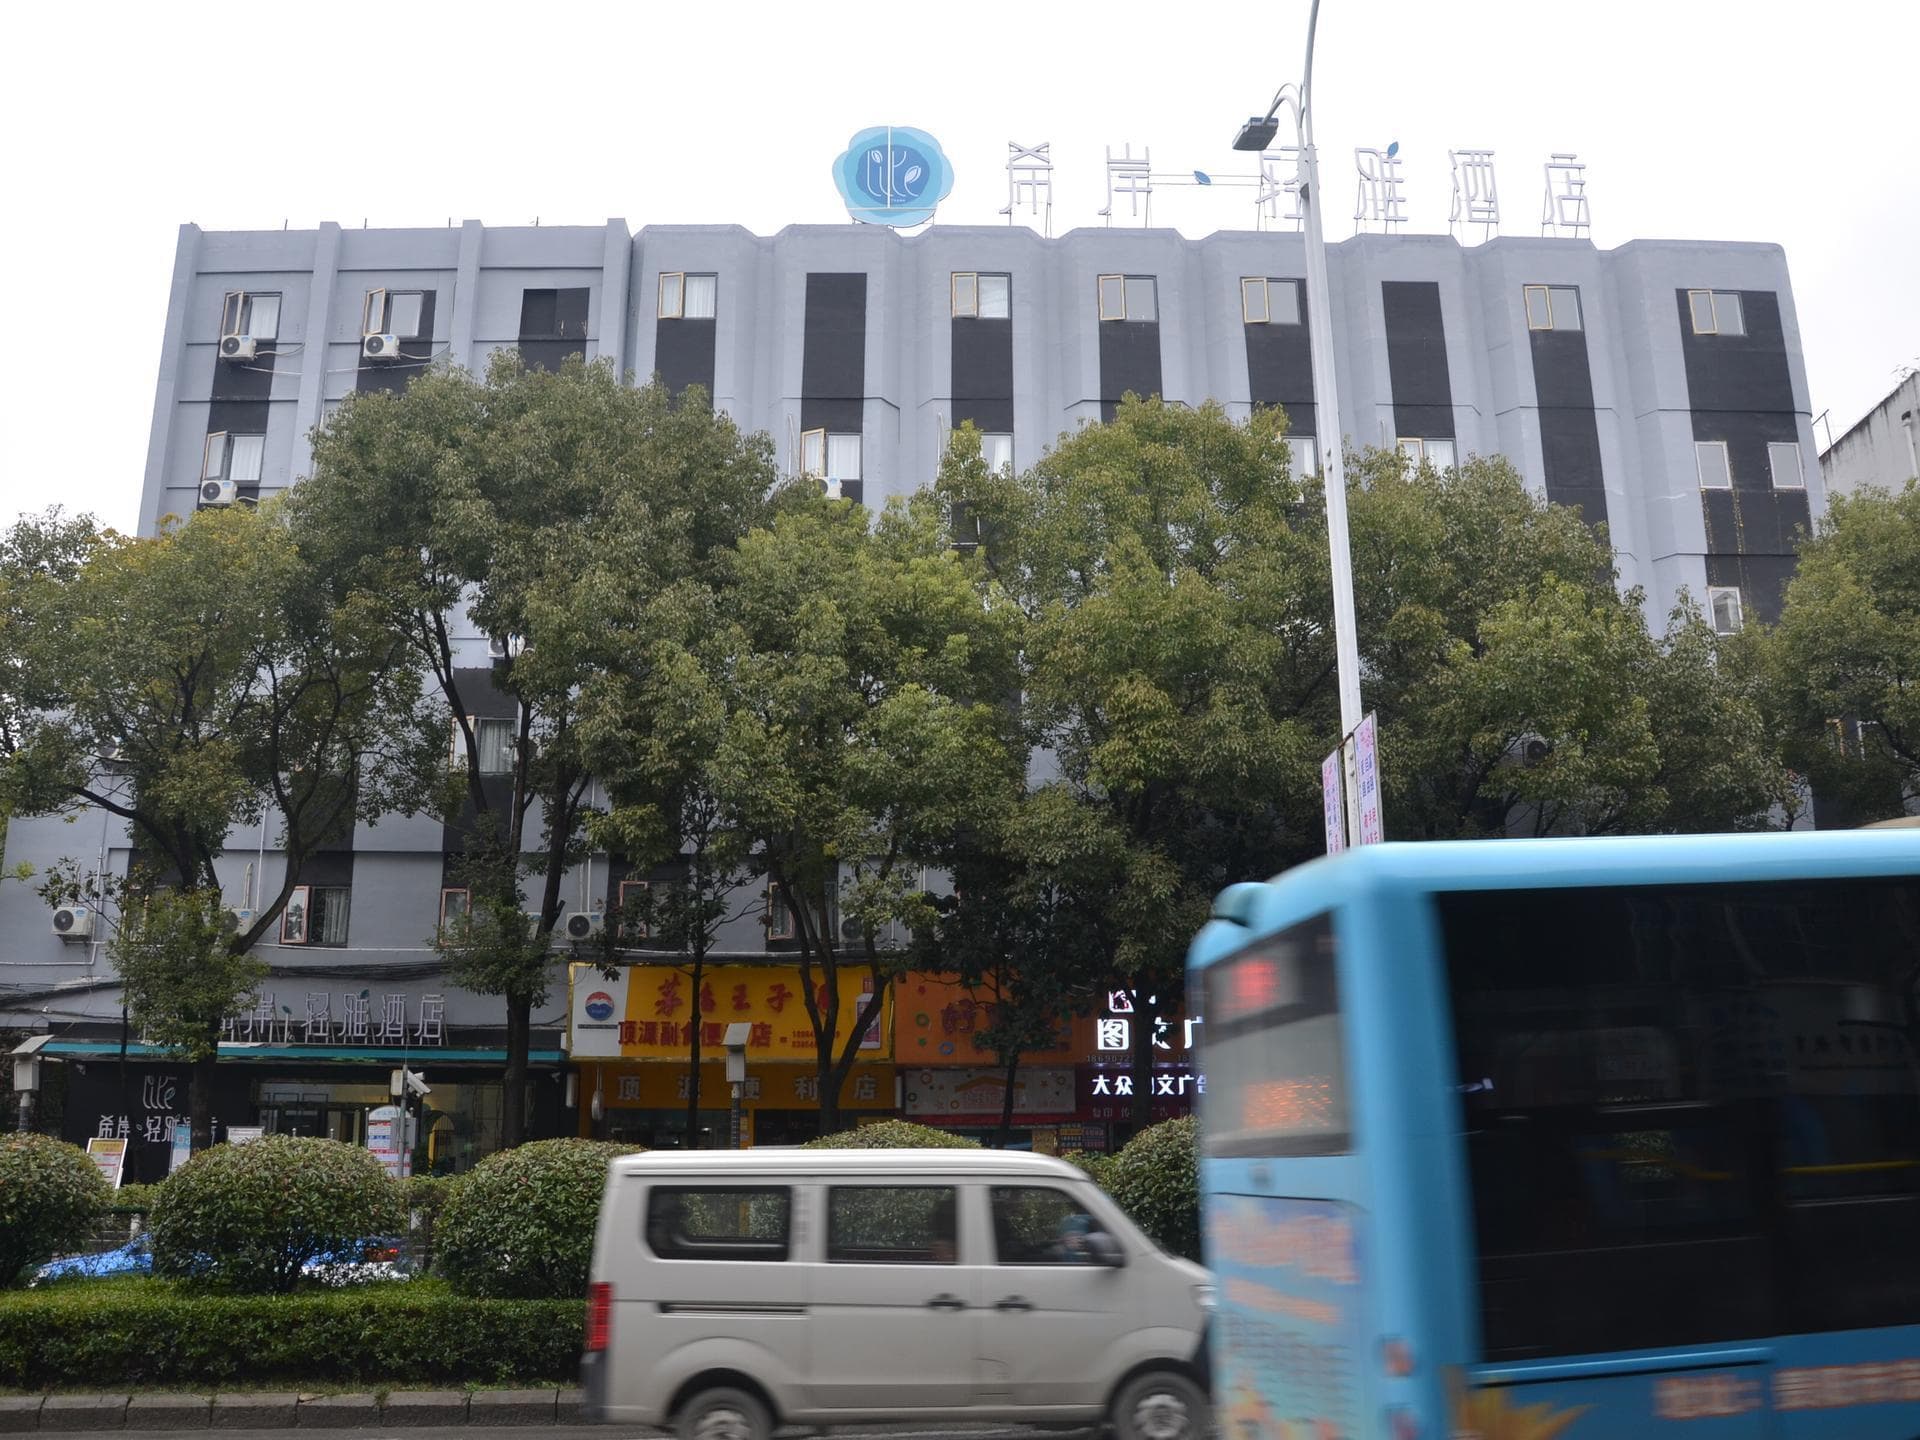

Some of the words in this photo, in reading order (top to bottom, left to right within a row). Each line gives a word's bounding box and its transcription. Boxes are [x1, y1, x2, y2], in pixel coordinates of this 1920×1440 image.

[1091, 1073, 1207, 1096] 大众文广告
